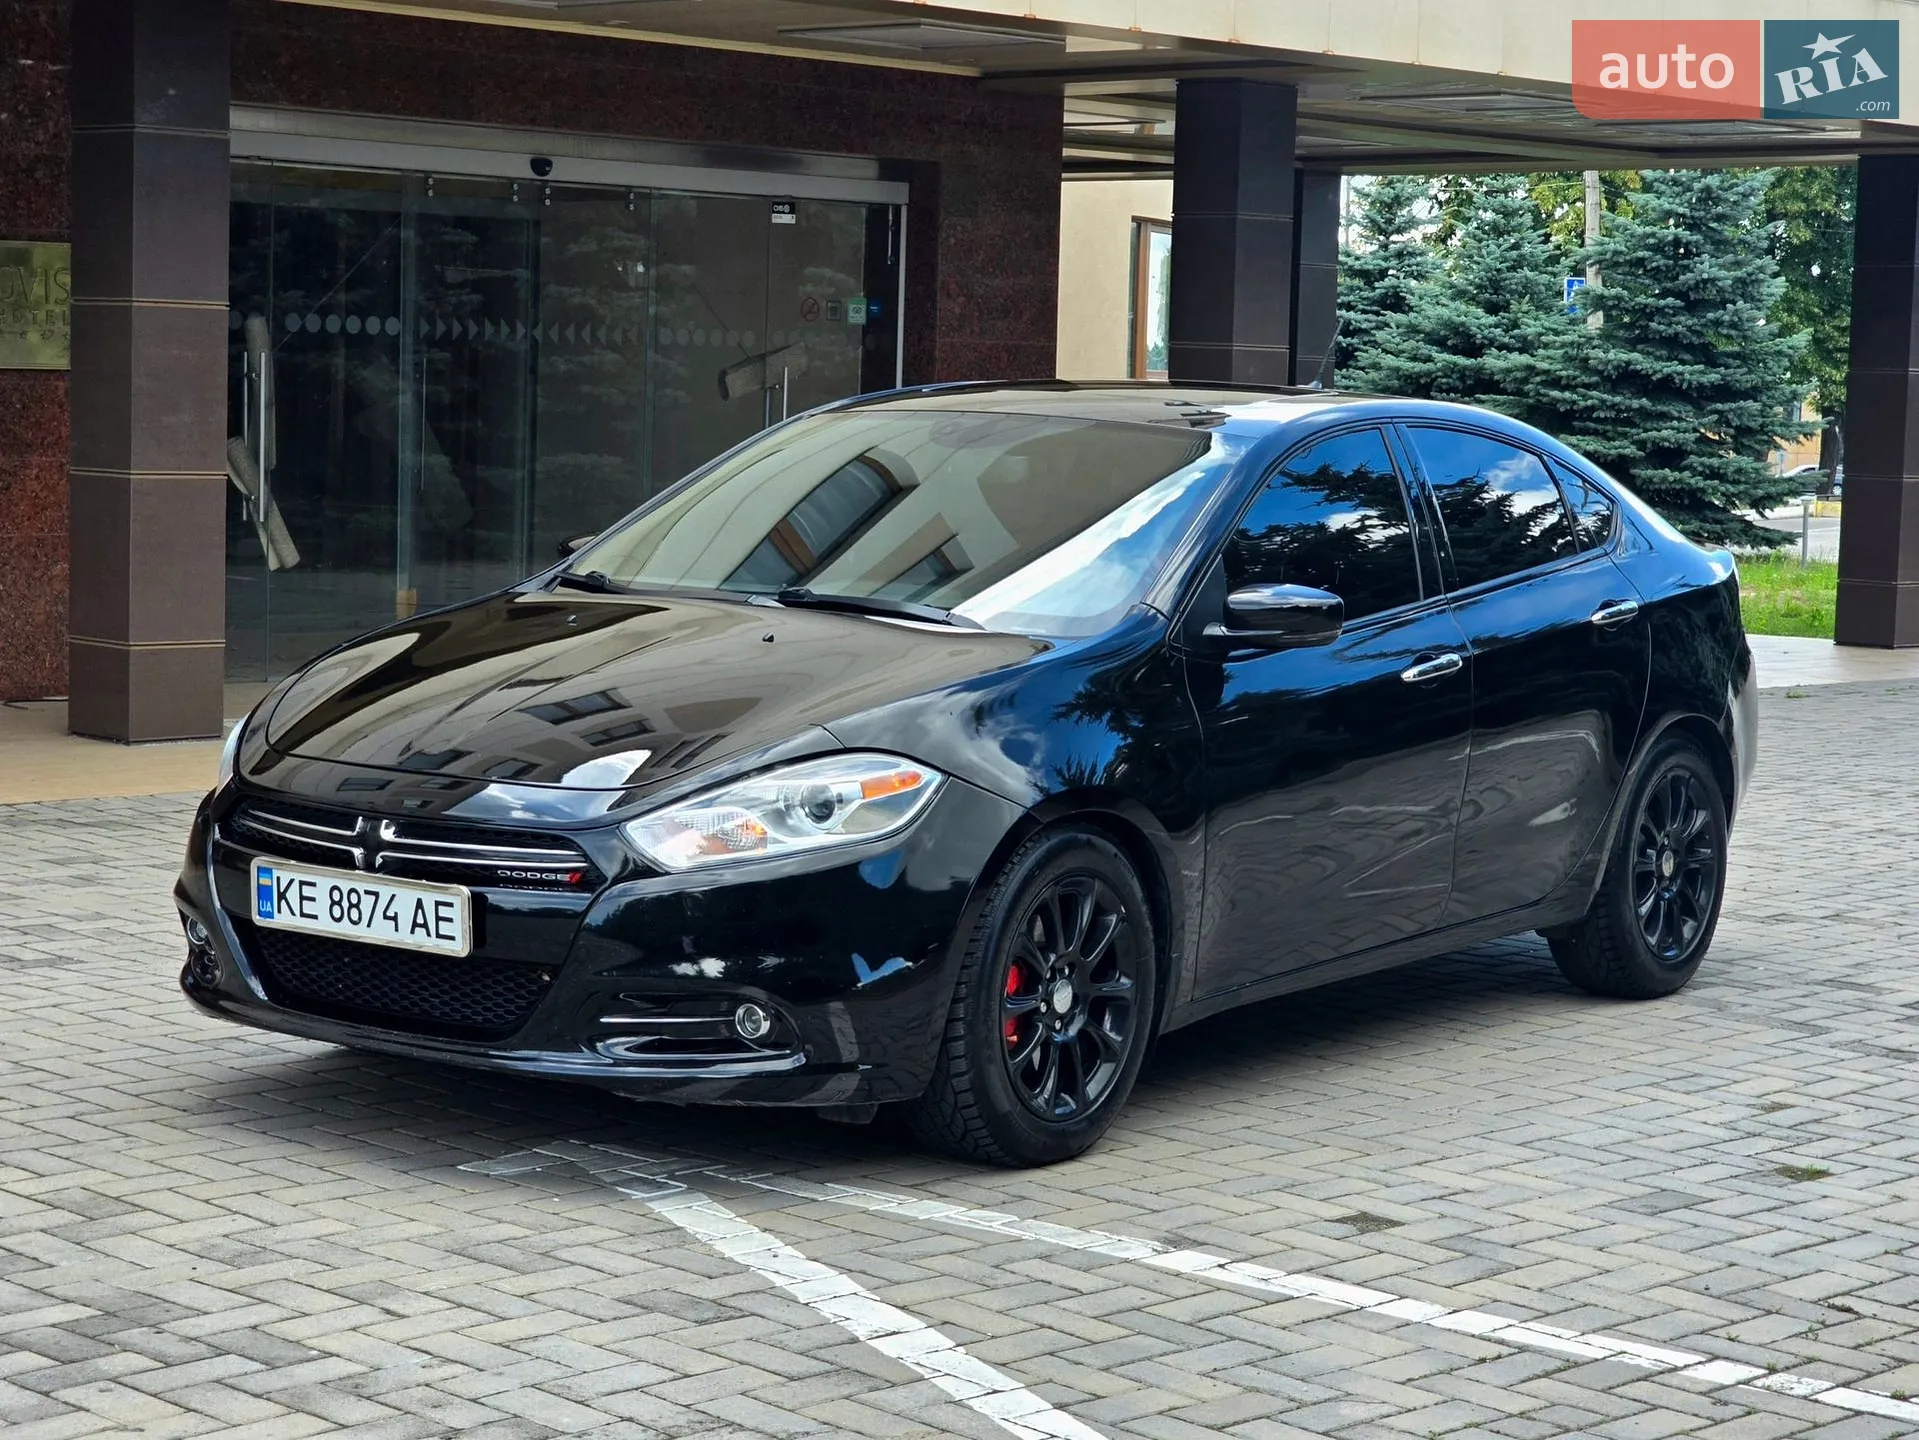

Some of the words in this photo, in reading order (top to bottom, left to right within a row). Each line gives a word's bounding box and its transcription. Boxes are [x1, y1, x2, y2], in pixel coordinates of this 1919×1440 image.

[497, 869, 570, 882] DODGE
[259, 899, 273, 913] UA
[276, 875, 319, 920] KE
[328, 884, 400, 932] 8874
[410, 897, 457, 941] AE
